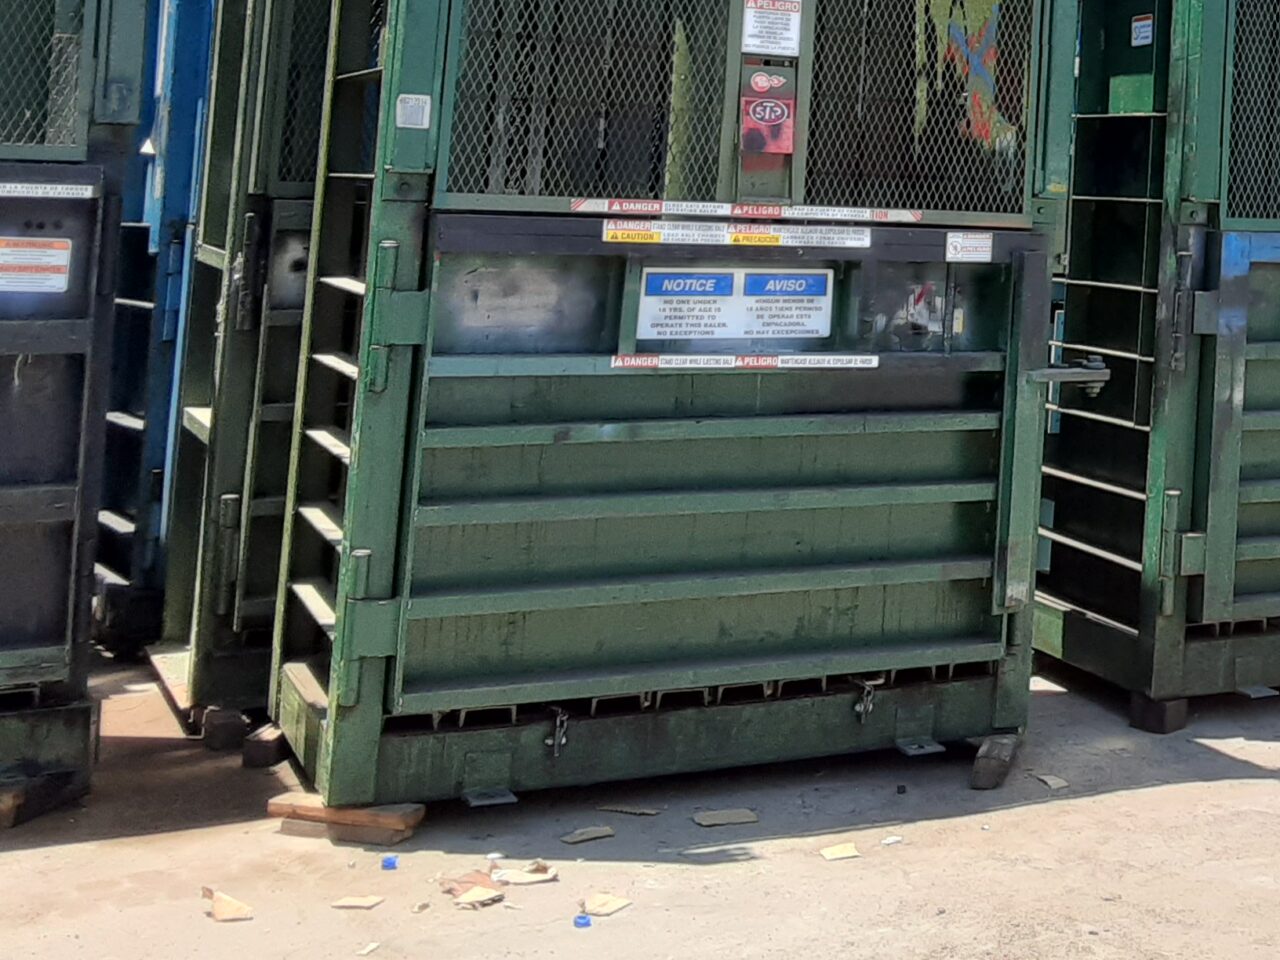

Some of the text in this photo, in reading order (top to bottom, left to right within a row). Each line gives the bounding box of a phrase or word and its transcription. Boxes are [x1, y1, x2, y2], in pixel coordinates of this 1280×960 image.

[756, 0, 799, 11] PELIGRO
[755, 102, 782, 120] STP
[622, 201, 661, 212] DANGER
[742, 205, 780, 215] PELIGRO
[869, 209, 889, 220] TION
[617, 221, 651, 230] DANGER
[736, 225, 770, 234] PELIGRO
[621, 232, 654, 241] CAUTION
[661, 279, 717, 291] NOTICE
[764, 279, 806, 291] AVISO
[623, 356, 659, 367] DANGER
[743, 357, 779, 367] PELIGRO
